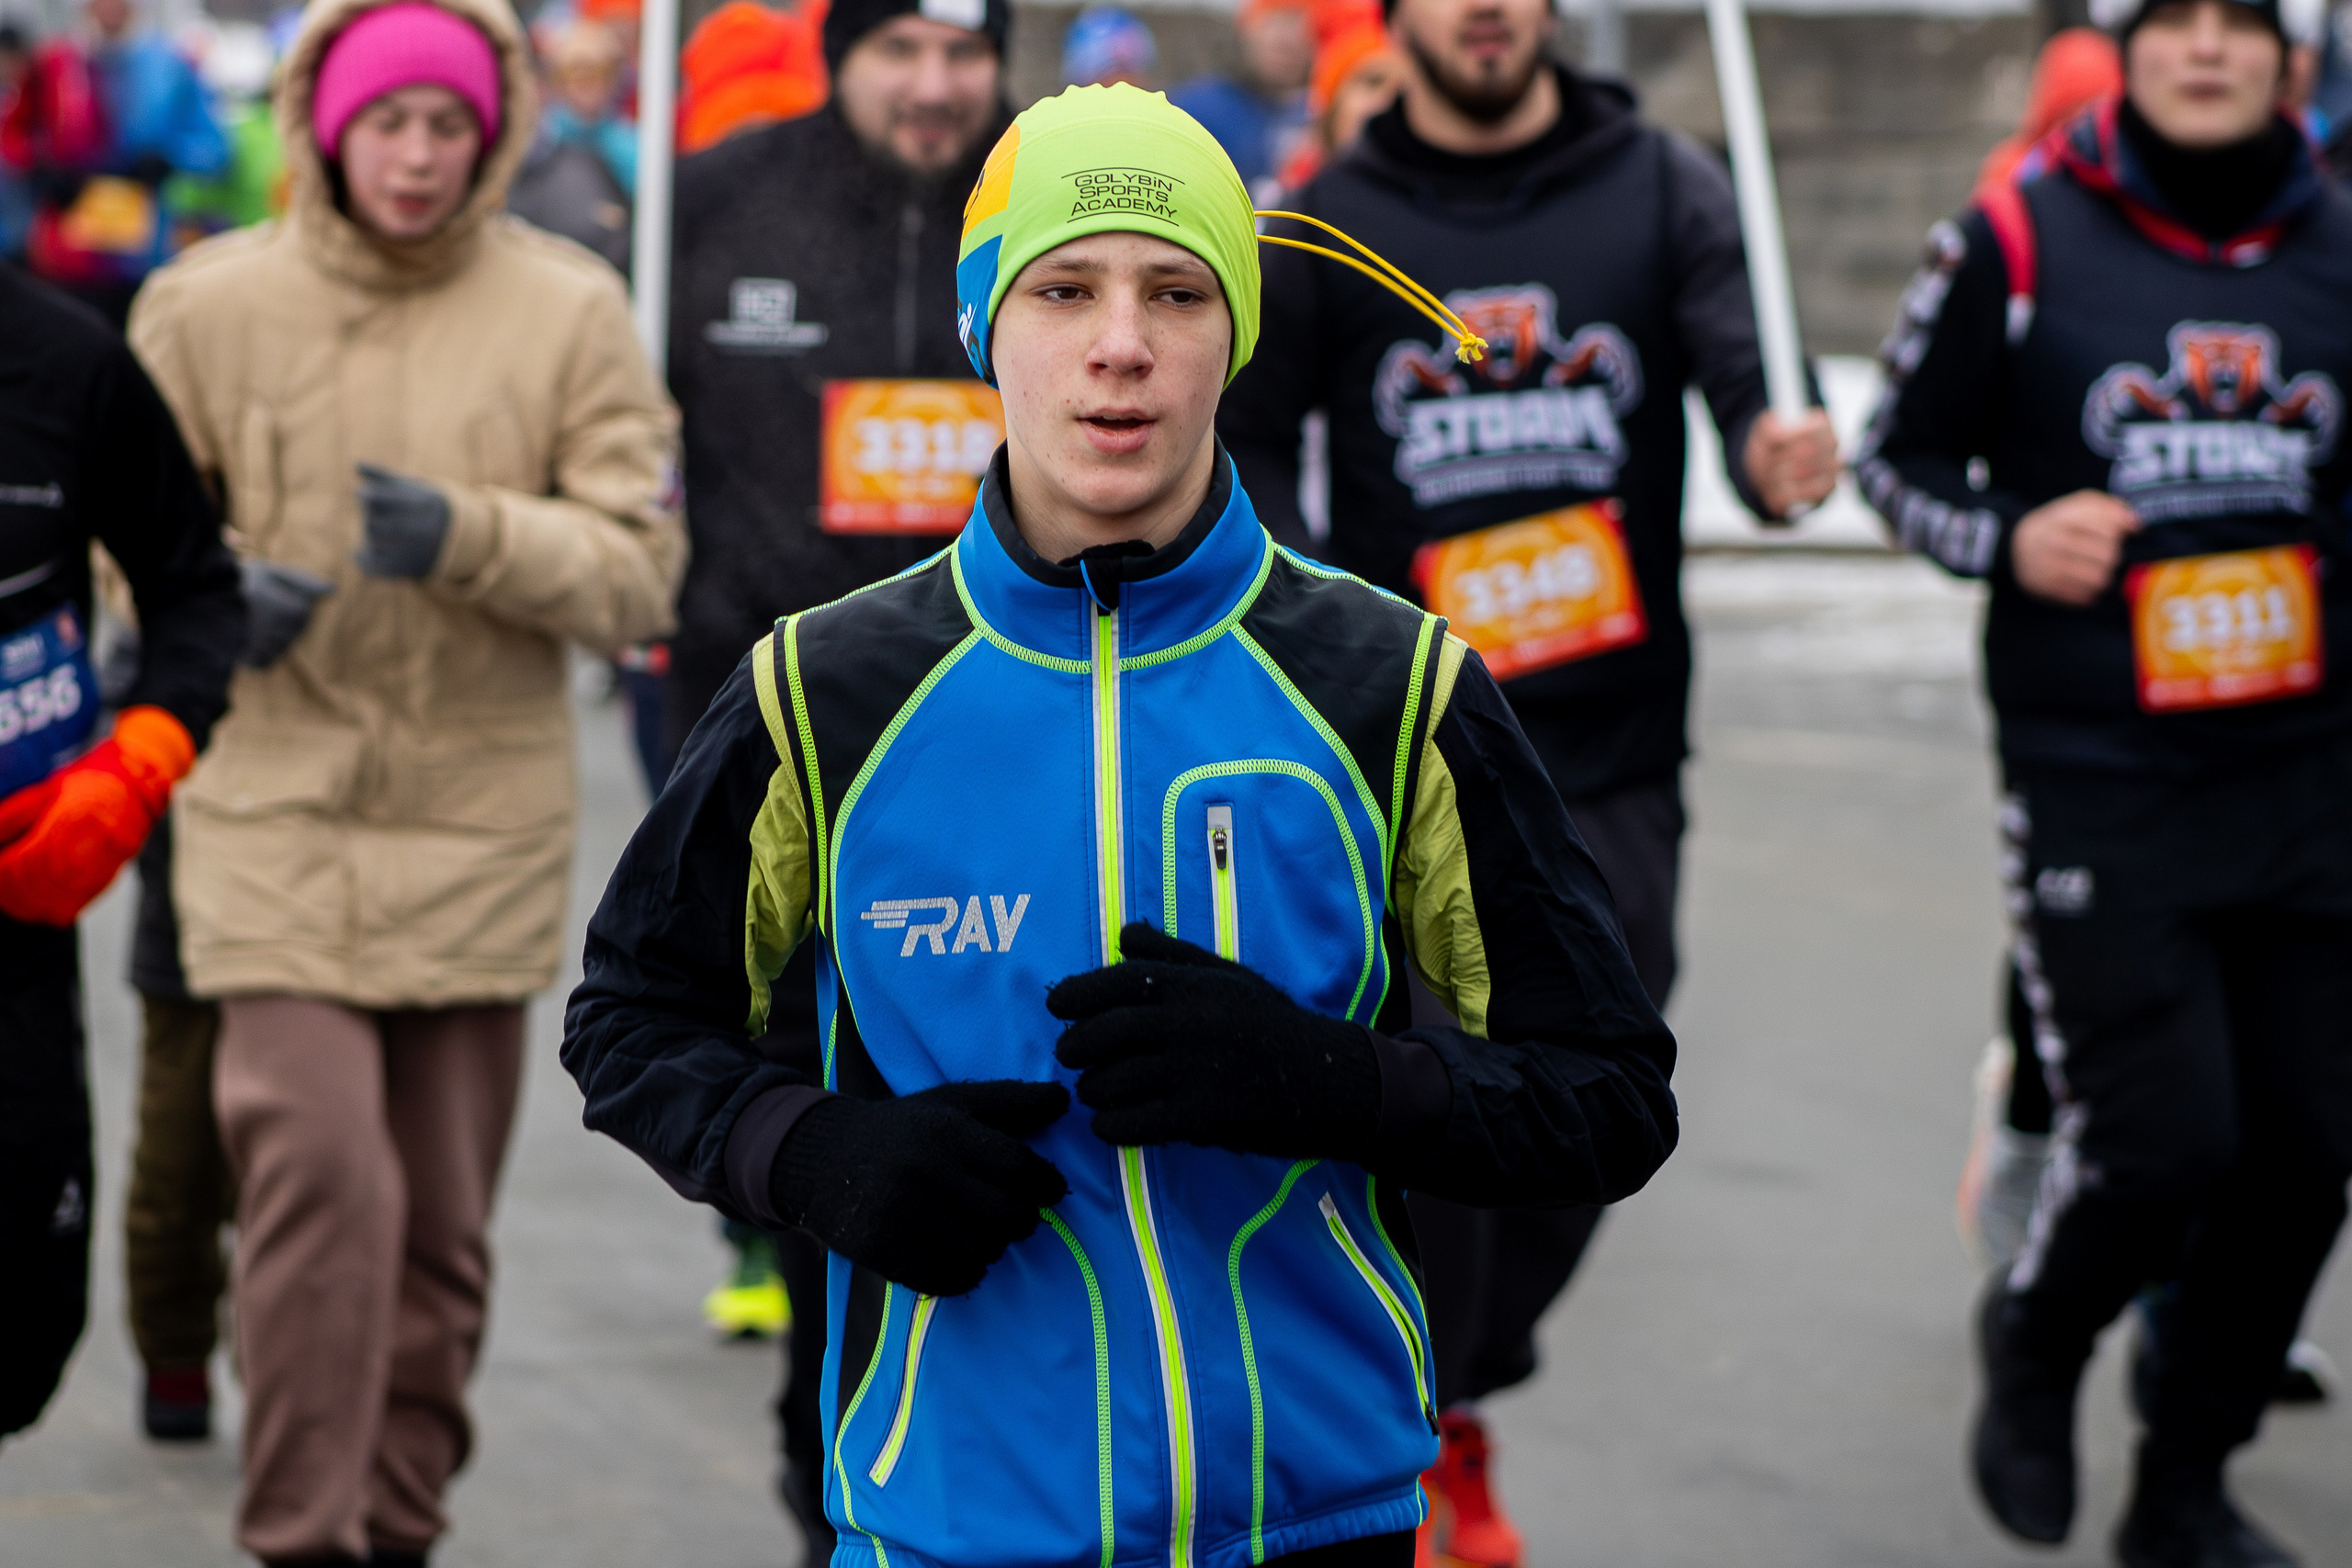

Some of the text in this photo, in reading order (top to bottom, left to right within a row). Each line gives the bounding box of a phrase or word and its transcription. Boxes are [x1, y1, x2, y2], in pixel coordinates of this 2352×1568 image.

[1070, 197, 1177, 218] ACADEMY
[1080, 185, 1169, 203] SPORTS
[2162, 584, 2290, 653] 3311
[861, 894, 1031, 957] RAY
